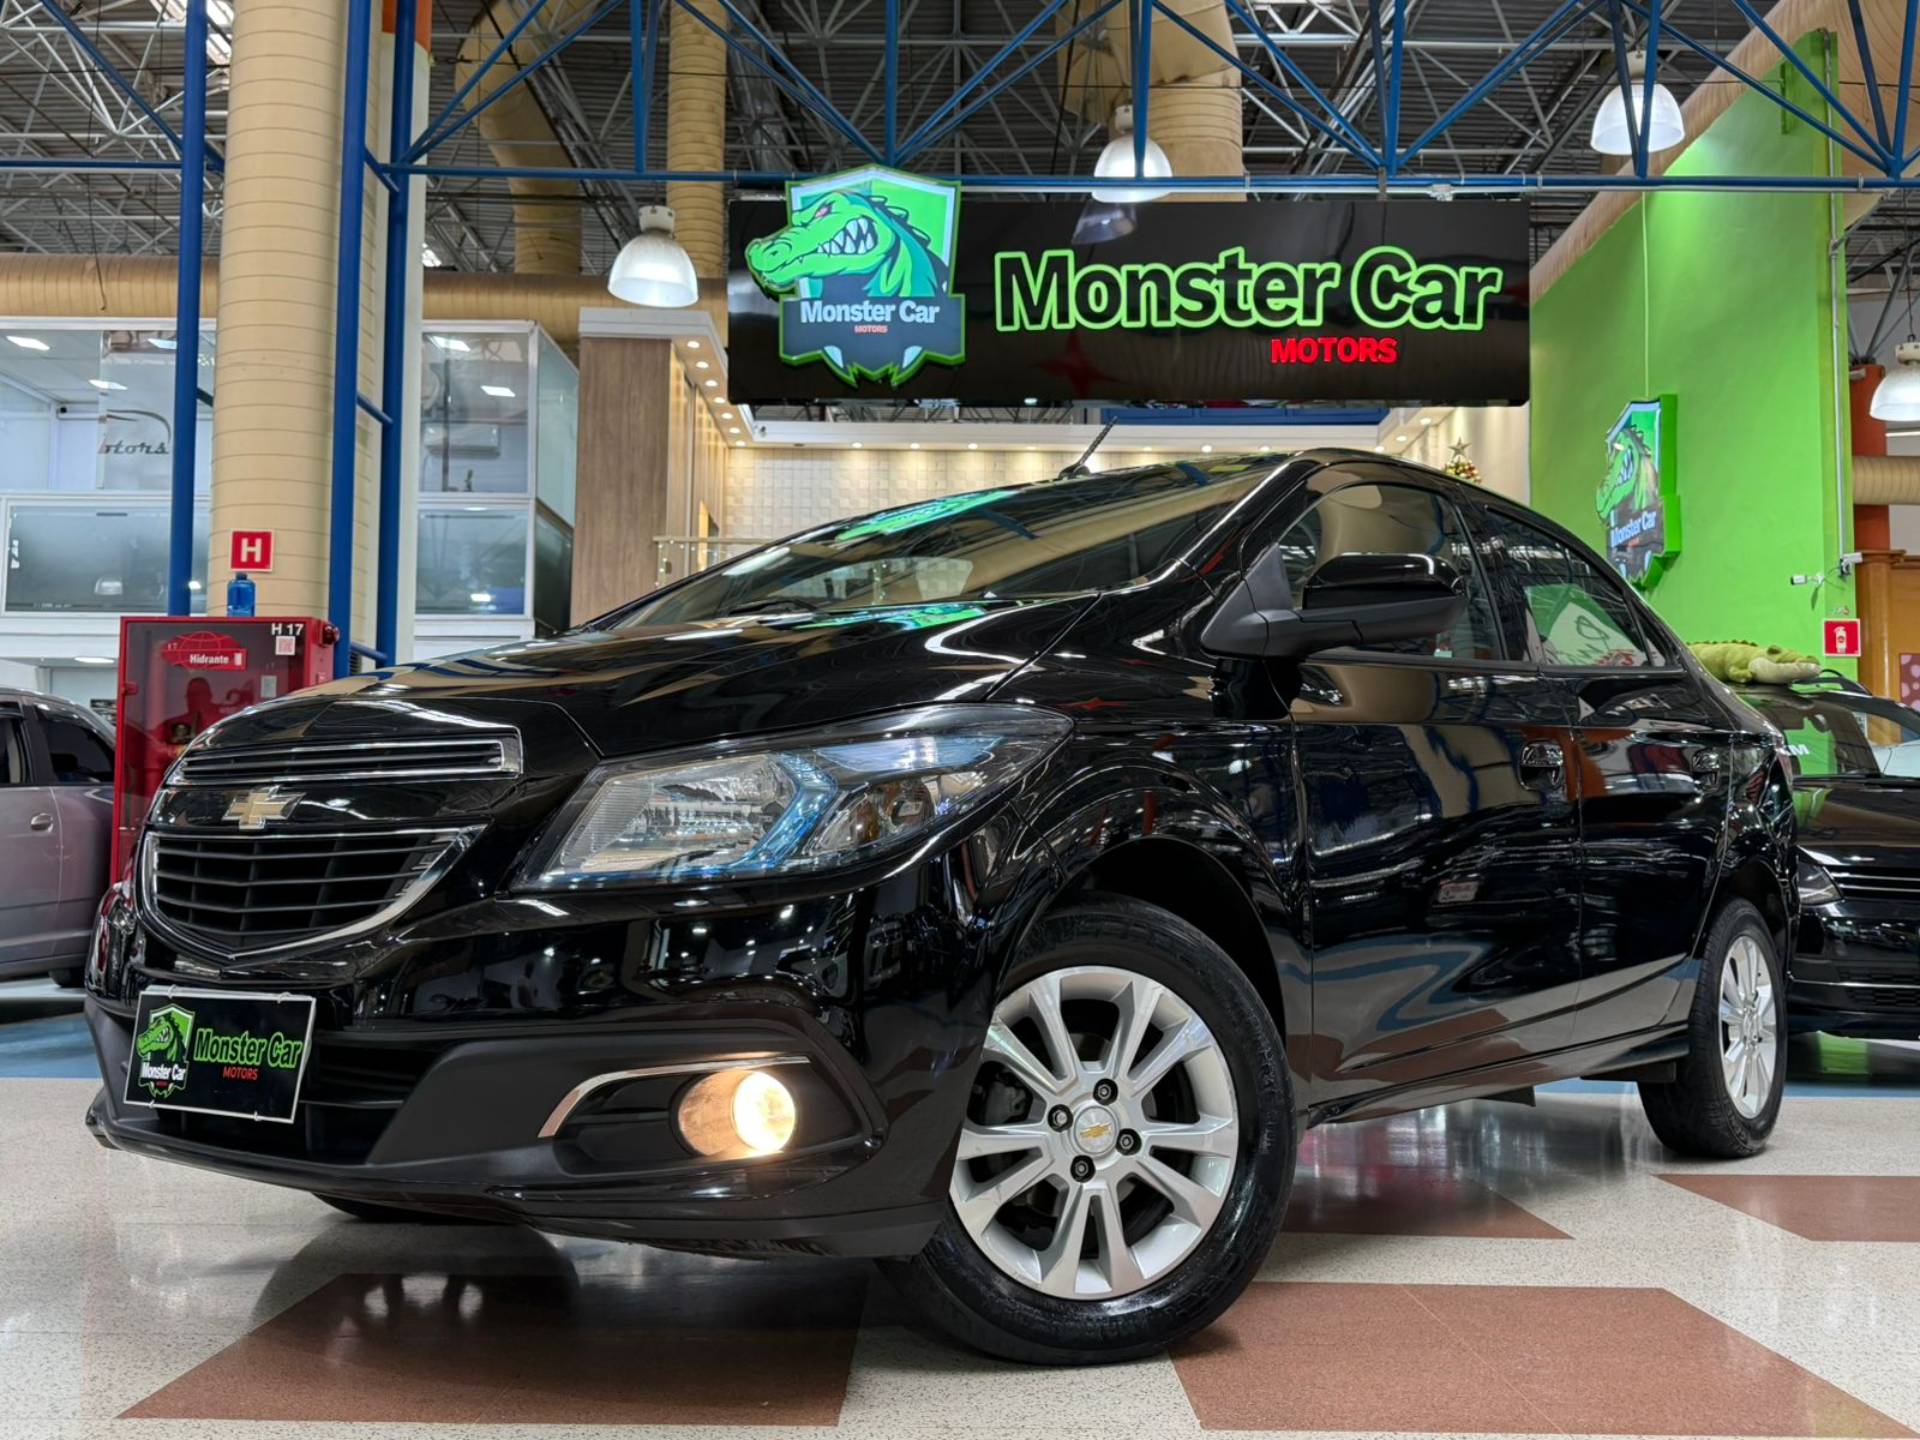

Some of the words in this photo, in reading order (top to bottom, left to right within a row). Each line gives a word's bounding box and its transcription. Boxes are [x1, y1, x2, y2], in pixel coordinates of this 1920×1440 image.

[995, 246, 1341, 332] Monster
[1351, 245, 1503, 331] Car
[800, 301, 896, 323] Monster
[899, 301, 940, 323] Car
[1270, 336, 1399, 364] MOTORS
[241, 538, 262, 562] H
[271, 623, 282, 635] H
[286, 623, 304, 636] 17
[190, 654, 229, 664] Hidrante
[194, 1028, 267, 1065] Monster
[267, 1032, 303, 1068] Car
[141, 1062, 171, 1080] Monster
[172, 1063, 186, 1080] Car
[223, 1066, 258, 1080] MOTORS
